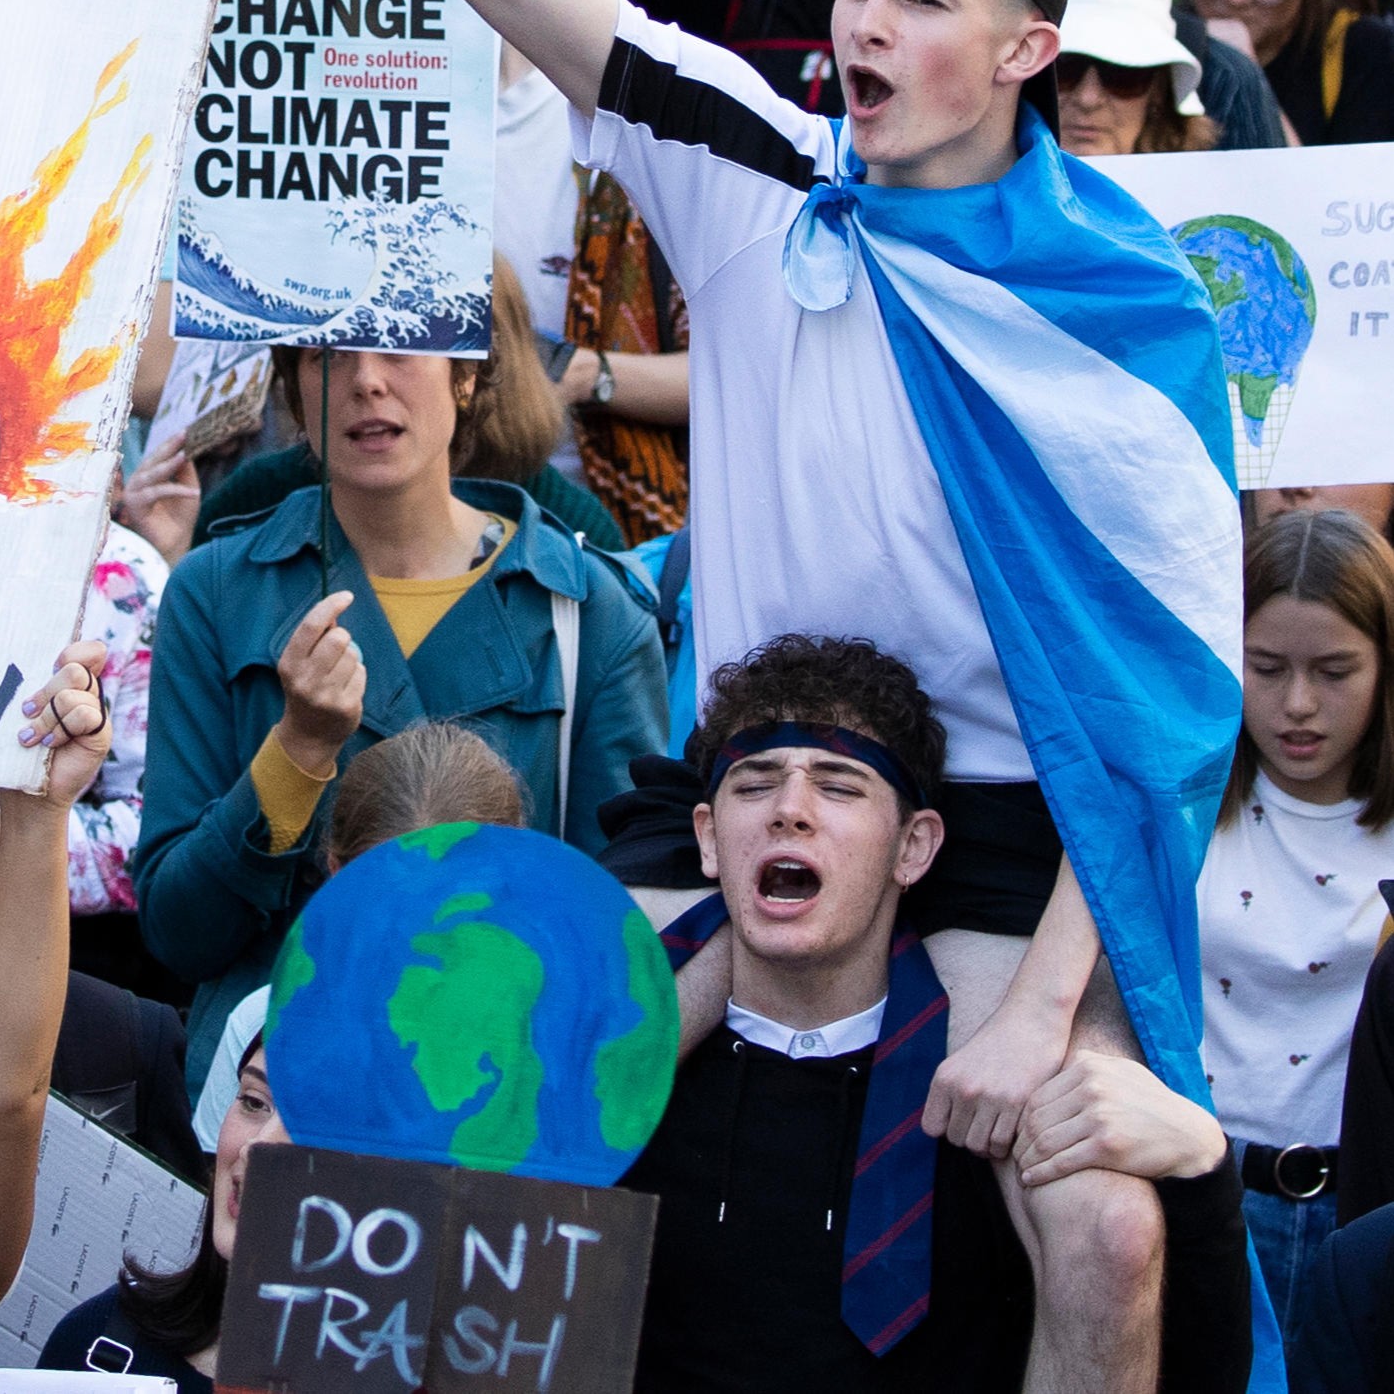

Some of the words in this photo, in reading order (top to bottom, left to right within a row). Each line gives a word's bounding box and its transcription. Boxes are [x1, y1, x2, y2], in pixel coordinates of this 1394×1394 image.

[203, 39, 316, 91] NOT
[323, 47, 359, 68] One
[364, 51, 449, 70] solution:
[323, 71, 419, 91] revolution
[194, 93, 452, 151] CLIMATE
[193, 148, 445, 205] CHANGE
[282, 275, 353, 301] swp.org.uk
[1348, 310, 1390, 338] IT
[55, 1185, 71, 1221] LACOSTE
[125, 1191, 141, 1227] LACOSTE
[74, 1242, 90, 1279] LACOSTE
[23, 1293, 40, 1329] LACOSTE
[256, 1281, 569, 1394] TRASH
